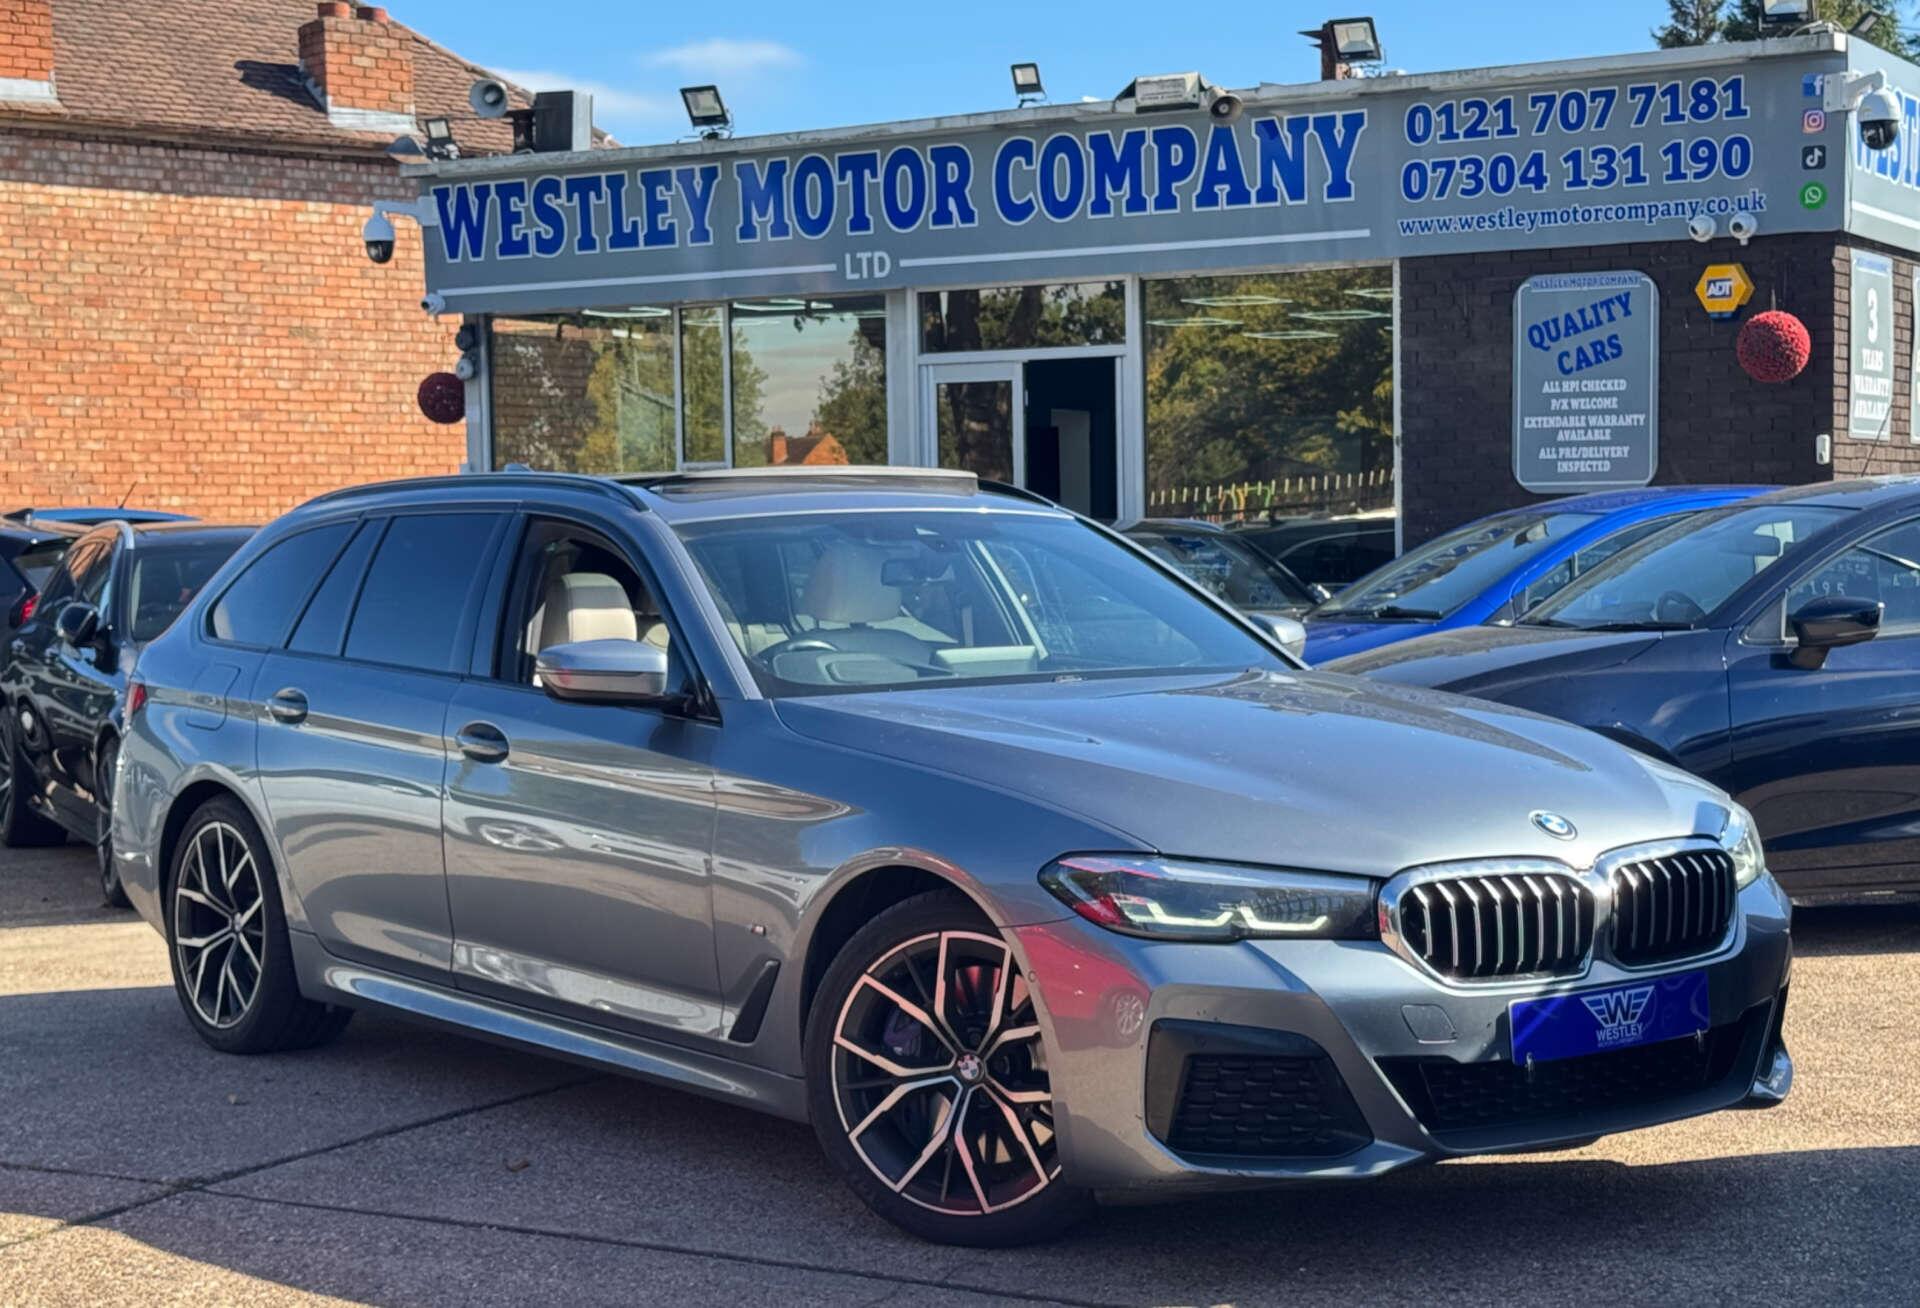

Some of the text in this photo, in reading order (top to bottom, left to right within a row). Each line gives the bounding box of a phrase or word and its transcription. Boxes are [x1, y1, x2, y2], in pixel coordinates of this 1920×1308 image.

[1405, 74, 1750, 146] 0121 707 7181
[1401, 133, 1753, 202] 07304 131 190
[430, 108, 1368, 263] WESTLEY MOTOR COMPANY
[1398, 190, 1766, 235] www.westleymotorcompany.co.uk
[845, 251, 891, 280] LTD
[1706, 281, 1733, 297] ADT
[1528, 291, 1632, 351] QUALITY
[1867, 287, 1879, 344] 3
[1557, 333, 1623, 375] CARS
[1542, 379, 1627, 393] ALL HPI CHECKED
[1550, 397, 1618, 410] P/X WELCOME
[1524, 413, 1646, 428] EXTENDABLE WARRANTY
[1557, 429, 1612, 441] AVAILABLE
[1539, 446, 1630, 459] ALL PRE/DELIVERY
[1557, 460, 1611, 472] INSPECTED
[1595, 1022, 1643, 1041] WESTLEY
